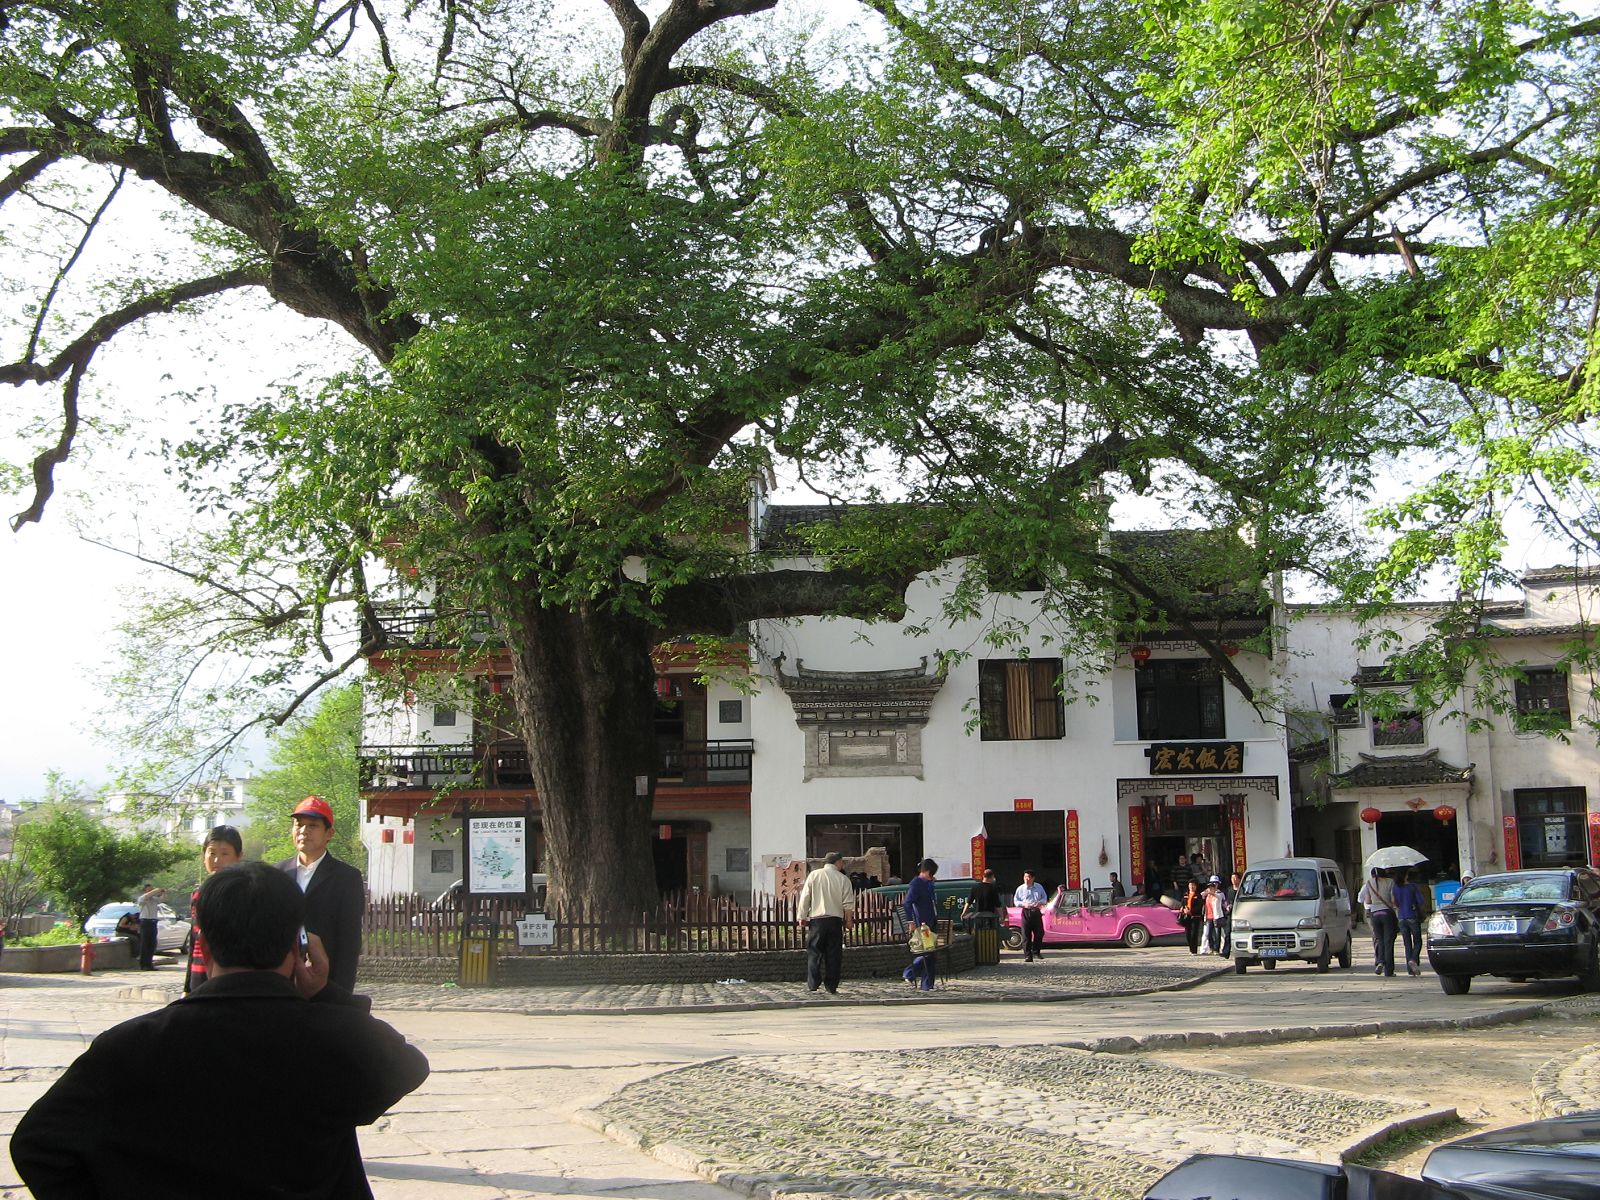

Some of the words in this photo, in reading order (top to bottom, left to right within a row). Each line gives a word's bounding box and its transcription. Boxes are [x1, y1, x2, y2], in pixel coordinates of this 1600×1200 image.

[1154, 744, 1239, 770] 宏发饭店
[473, 821, 521, 829] 您现在的位置
